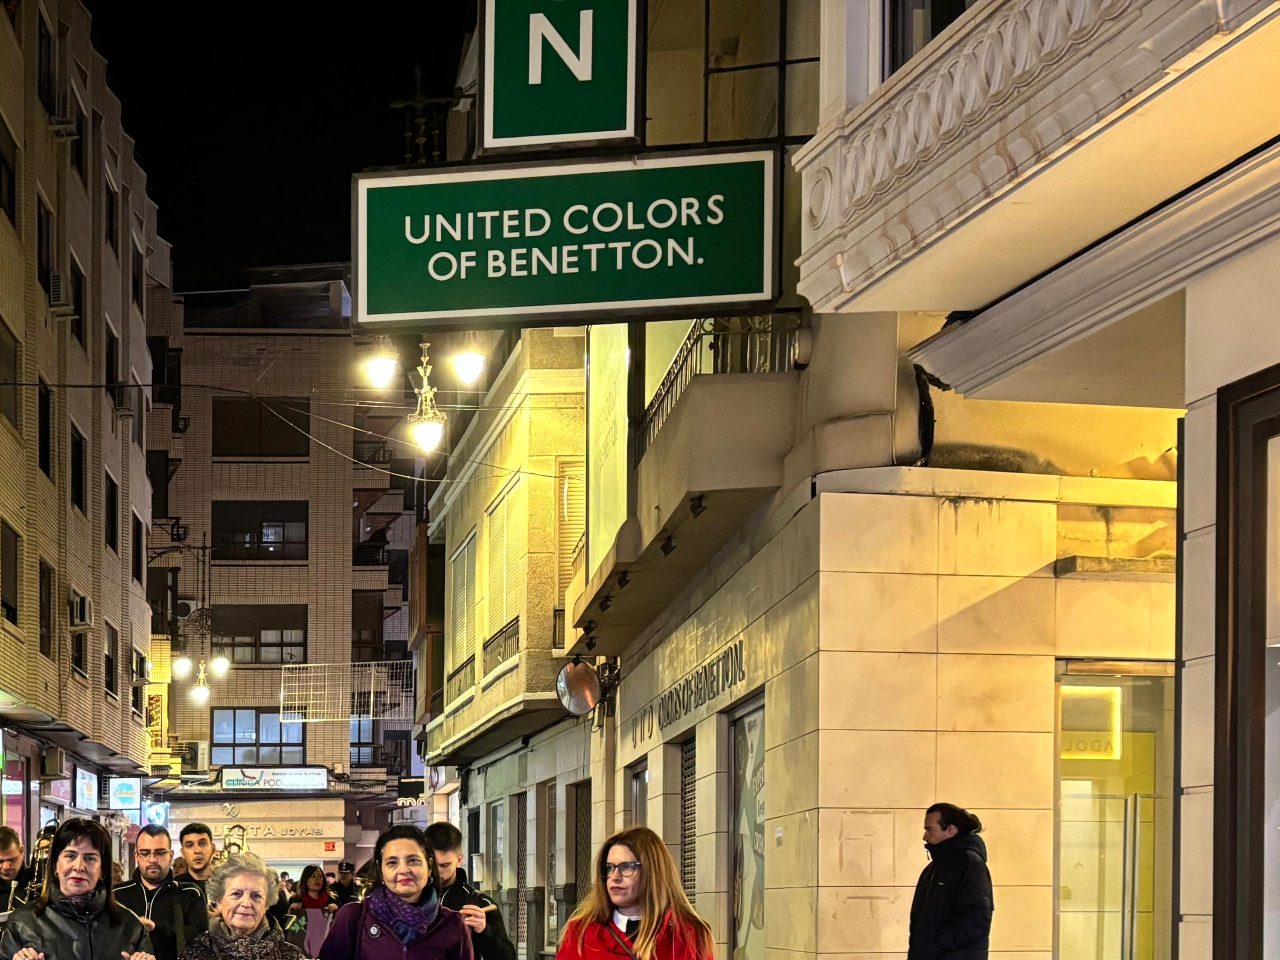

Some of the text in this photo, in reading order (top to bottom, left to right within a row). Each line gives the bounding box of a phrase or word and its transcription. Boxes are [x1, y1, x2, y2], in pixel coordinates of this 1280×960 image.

[528, 9, 593, 85] N
[404, 194, 724, 244] UNITED COLORS
[427, 237, 705, 282] OF BENETTON.
[280, 828, 323, 837] JOYAS
